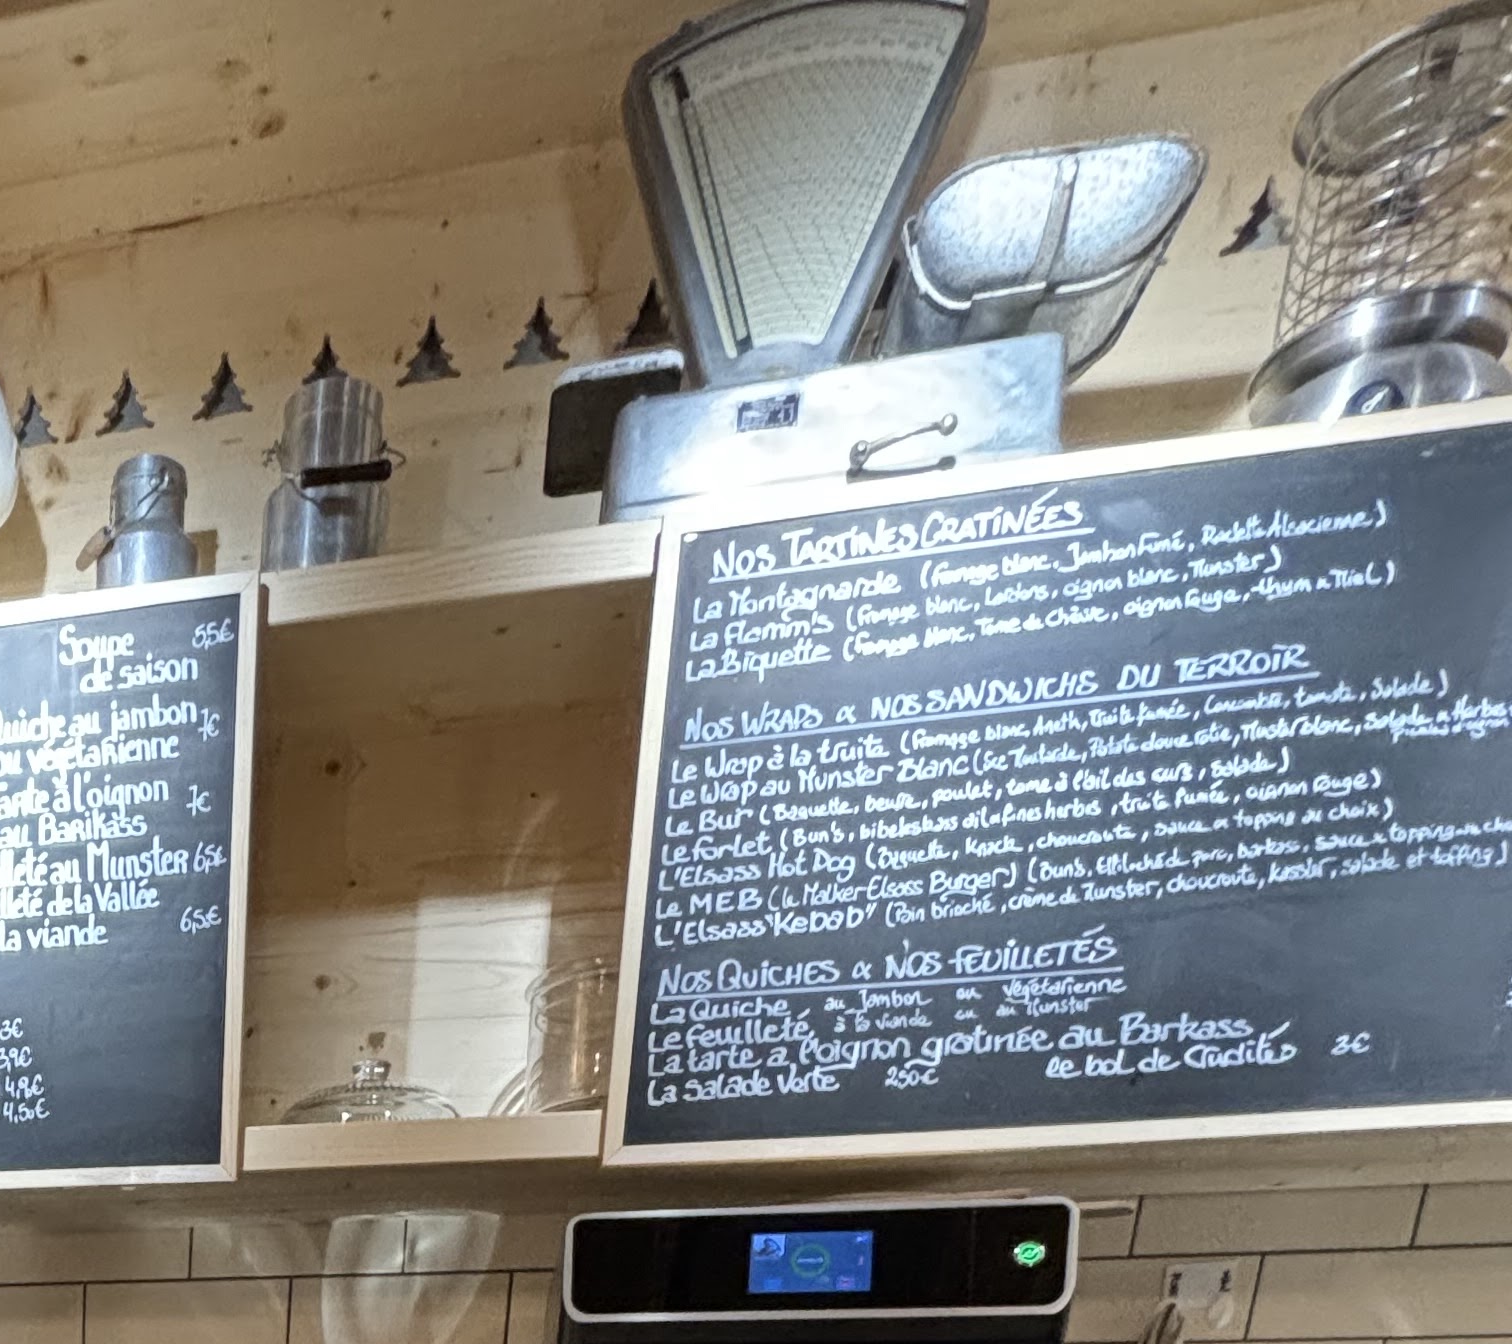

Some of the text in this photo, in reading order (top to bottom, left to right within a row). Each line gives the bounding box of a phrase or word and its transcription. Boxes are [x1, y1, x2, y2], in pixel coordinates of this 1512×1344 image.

[693, 597, 722, 623] La
[59, 623, 134, 670] Soupe
[690, 631, 718, 652] La
[80, 652, 198, 693] de saison
[686, 660, 716, 682] La
[1117, 664, 1161, 690] DU
[68, 712, 102, 737] au
[110, 693, 197, 743] jambon
[672, 759, 698, 784] Le
[790, 743, 811, 767] la
[74, 772, 169, 817] l'oignon
[669, 788, 697, 809] Le
[760, 780, 790, 796] au
[665, 817, 693, 837] Le
[50, 859, 82, 885] au
[87, 835, 188, 882] Munster
[661, 844, 692, 866] Le
[768, 851, 807, 878] Hot
[813, 848, 855, 883] Dog
[47, 885, 73, 916] de
[94, 878, 160, 912] Vallée
[656, 898, 682, 920] Le
[690, 888, 762, 915] MEB
[26, 914, 108, 949] viande
[650, 1003, 685, 1025] La
[690, 997, 790, 1021] Quiche
[648, 1032, 683, 1053] Le
[648, 1054, 684, 1076] La
[687, 1049, 762, 1072] tarte
[1058, 1025, 1116, 1049] au
[1119, 1011, 1254, 1046] Barkass
[1045, 1056, 1082, 1079] le
[1085, 1049, 1135, 1077] bol
[1137, 1047, 1181, 1074] de
[648, 1080, 677, 1106] La
[683, 1068, 773, 1102] Salade
